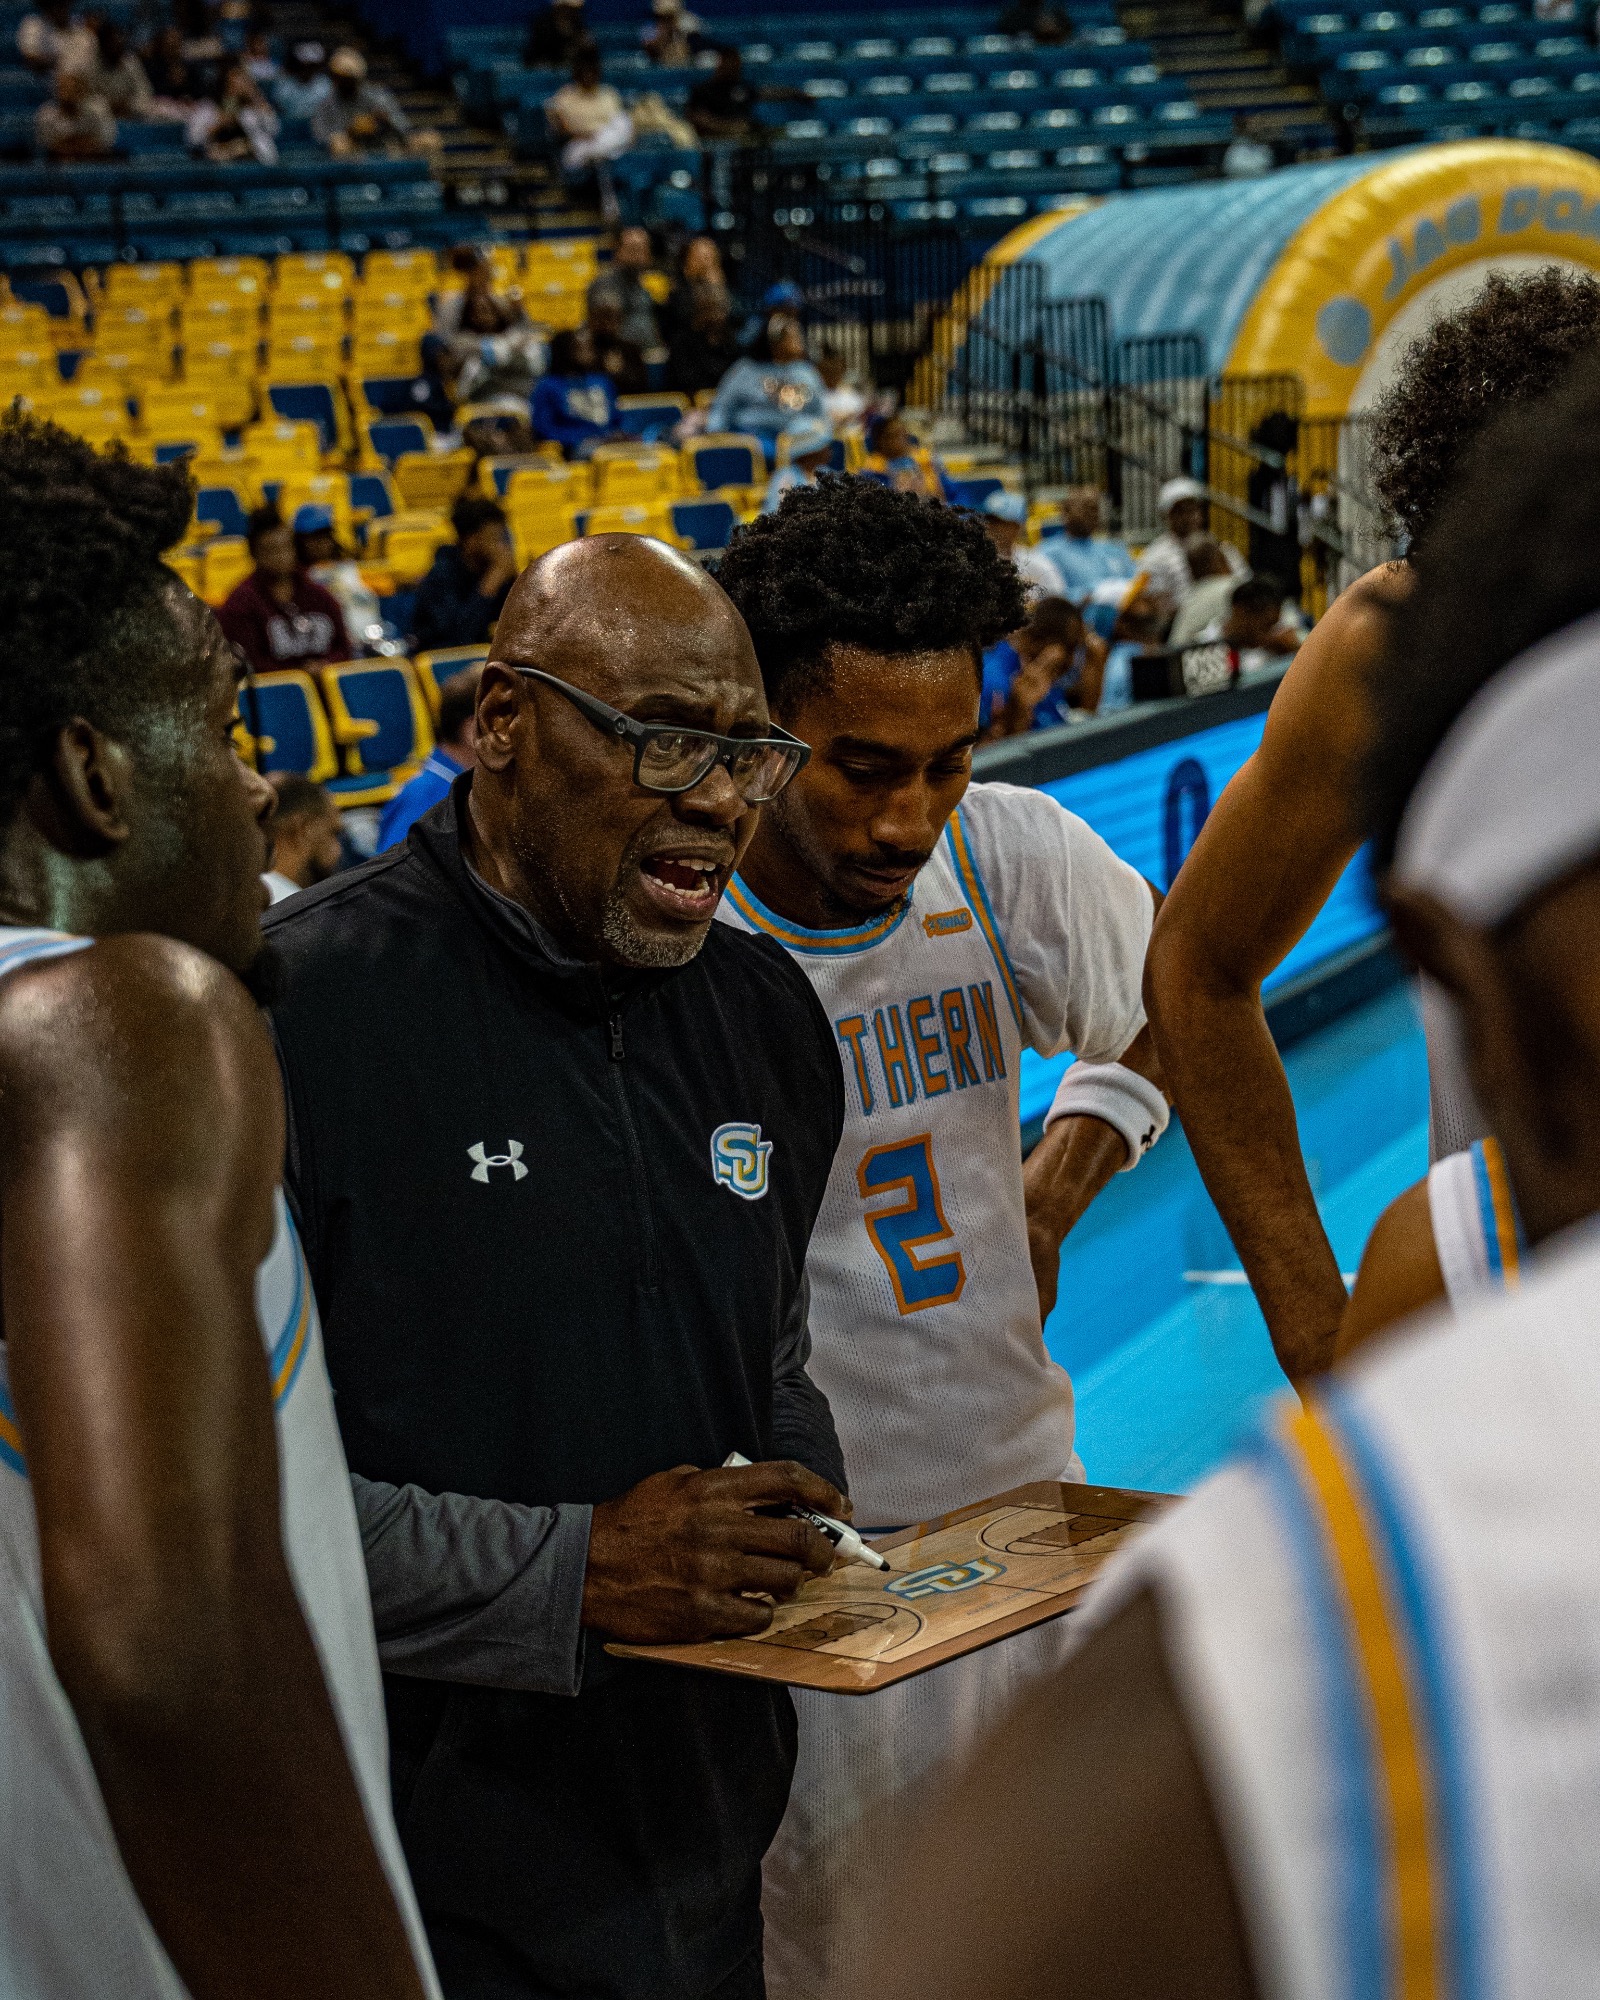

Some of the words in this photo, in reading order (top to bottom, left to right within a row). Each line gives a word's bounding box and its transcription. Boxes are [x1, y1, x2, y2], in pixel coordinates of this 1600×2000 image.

[835, 980, 1007, 1117] THERN
[710, 1122, 774, 1200] SU
[856, 1131, 967, 1316] 2
[883, 1555, 1007, 1600] SU
